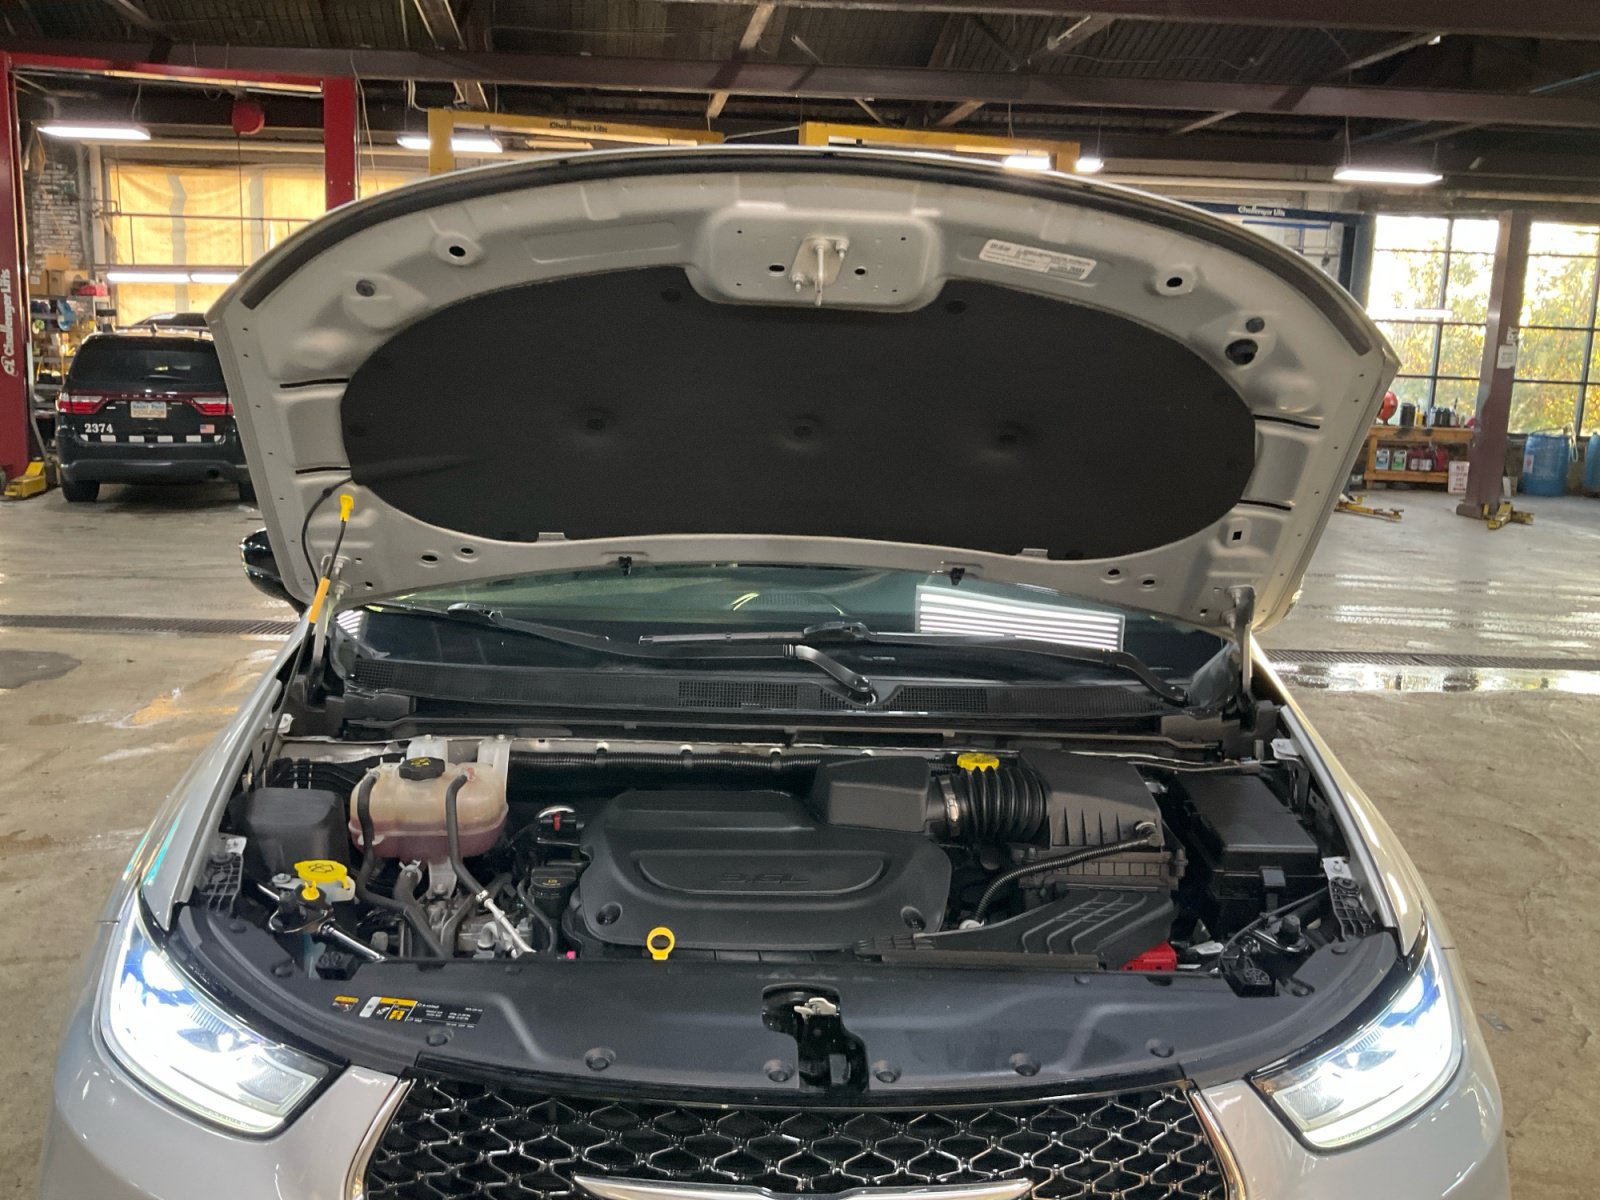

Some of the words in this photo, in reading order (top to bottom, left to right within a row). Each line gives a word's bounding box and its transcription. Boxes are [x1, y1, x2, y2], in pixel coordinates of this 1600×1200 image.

[1, 268, 11, 293] Lifts
[0, 293, 15, 357] Challenger
[84, 423, 114, 434] 2374
